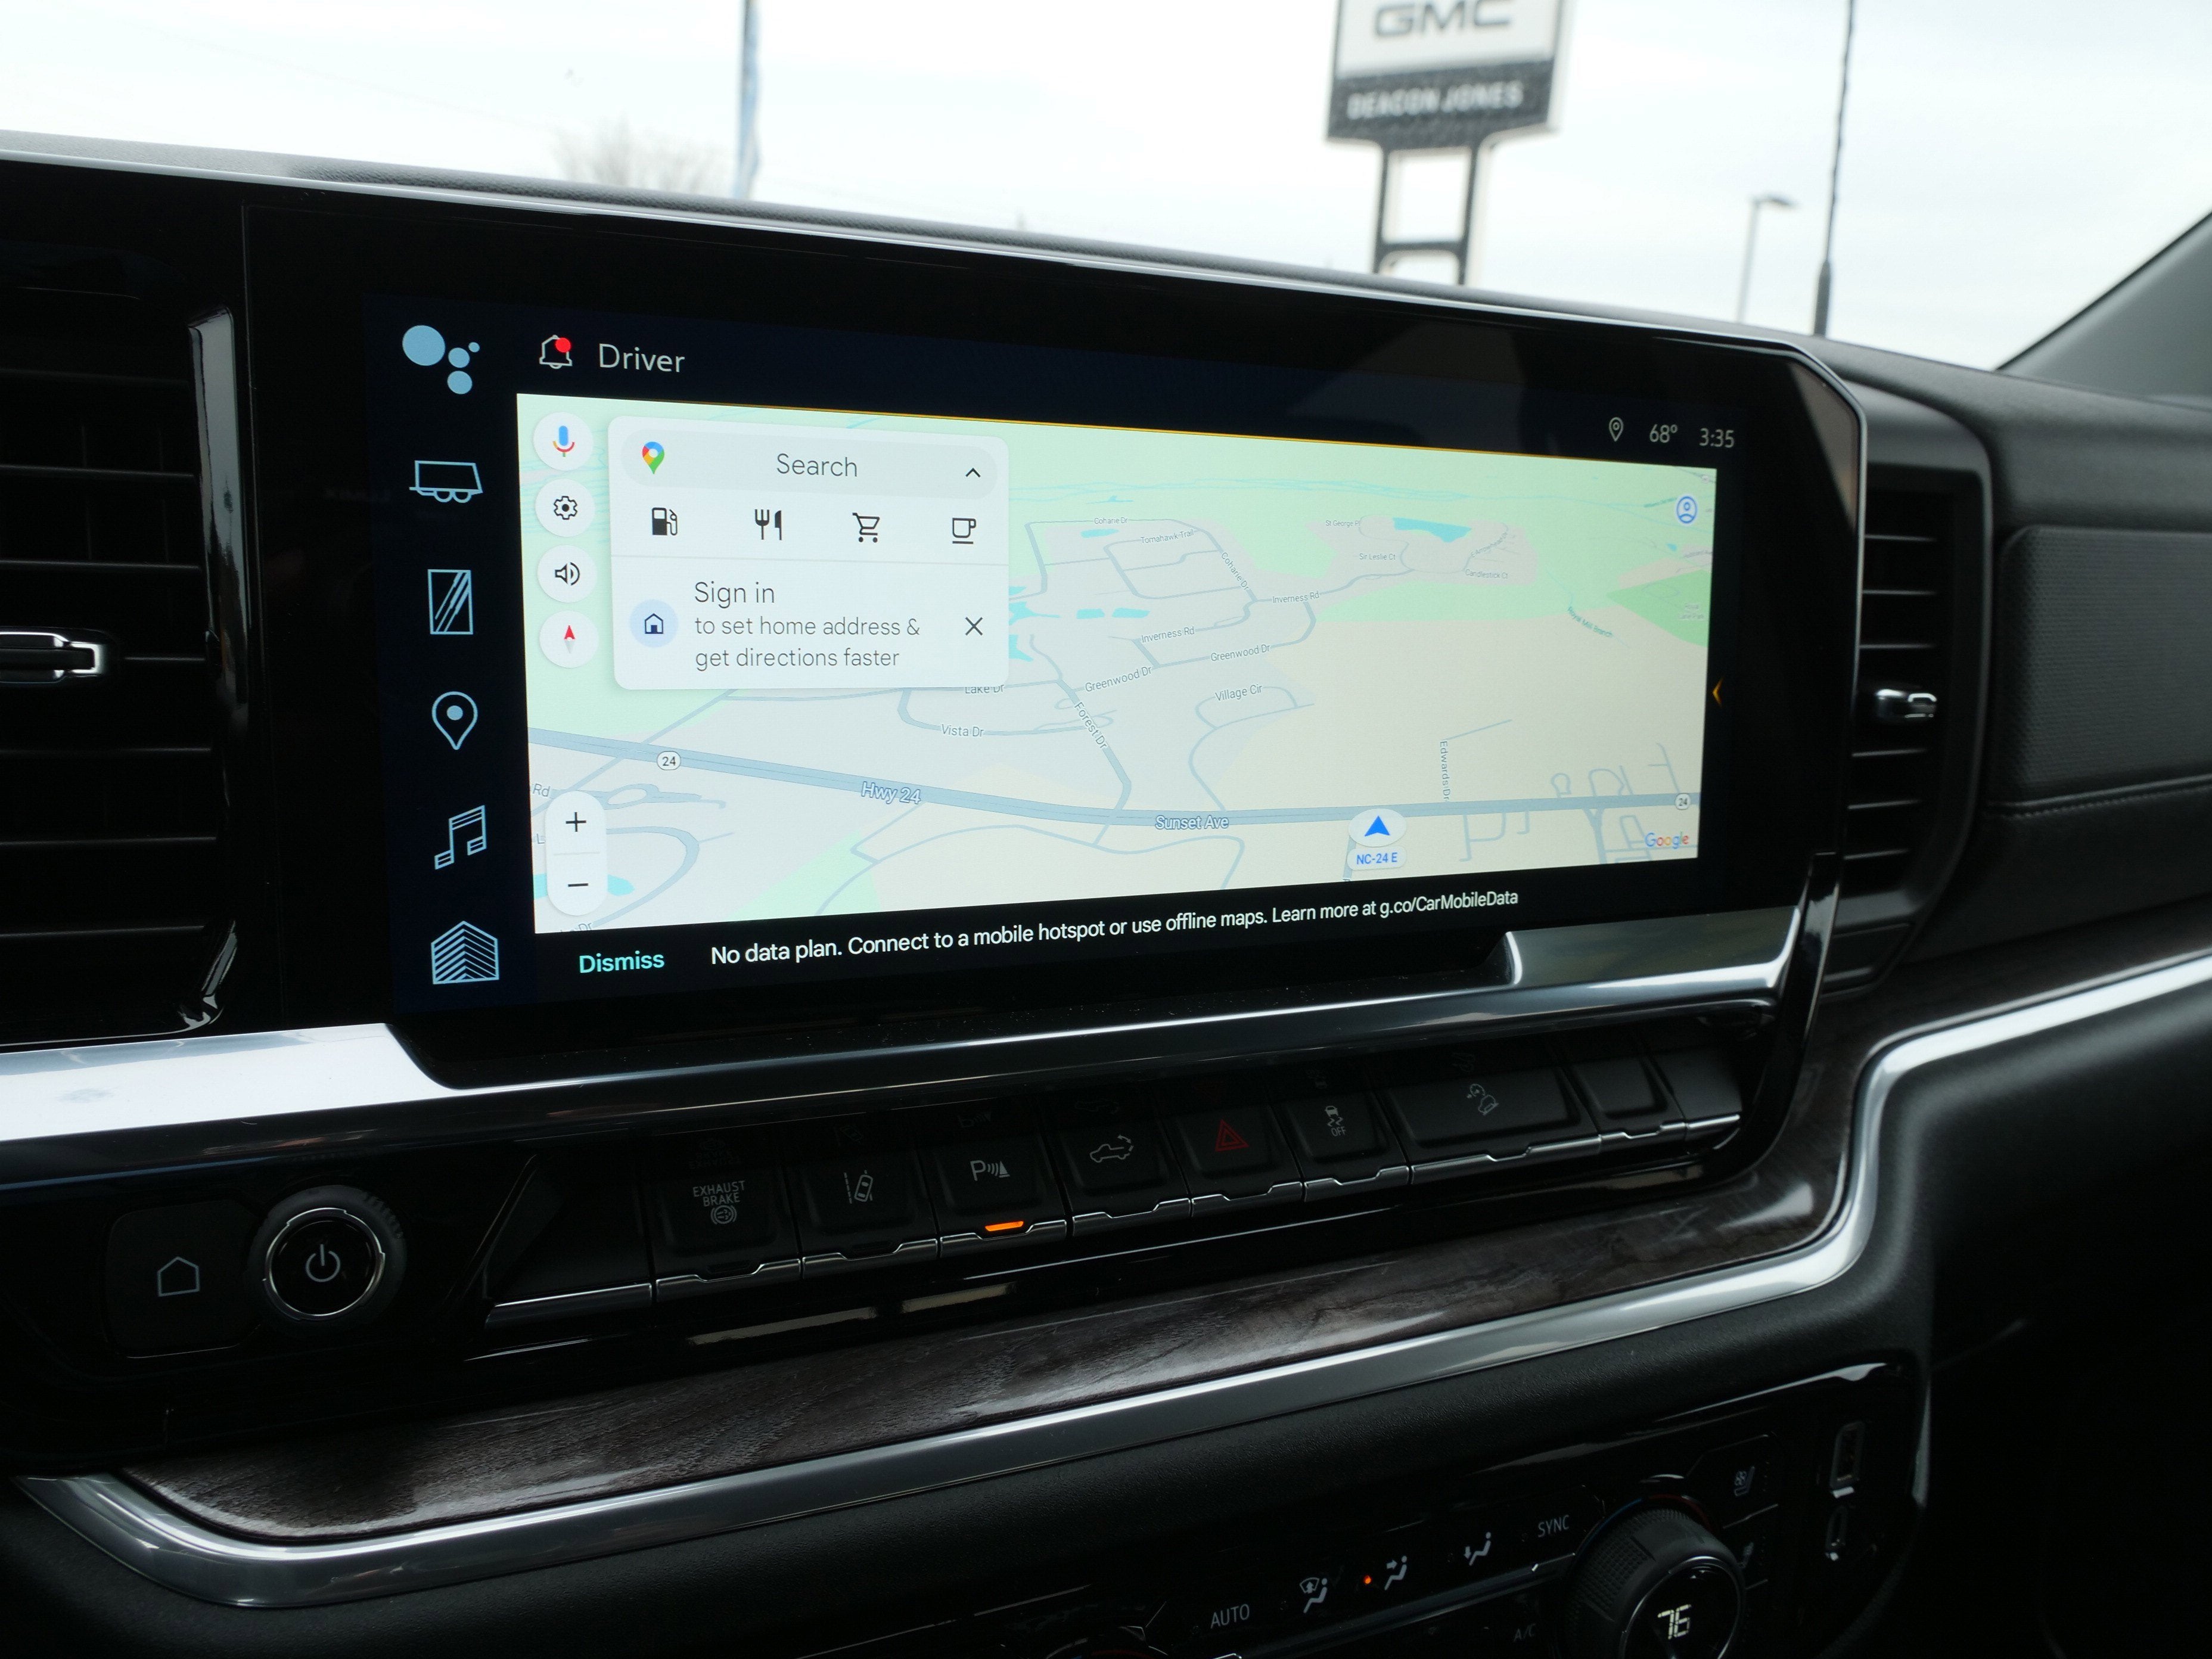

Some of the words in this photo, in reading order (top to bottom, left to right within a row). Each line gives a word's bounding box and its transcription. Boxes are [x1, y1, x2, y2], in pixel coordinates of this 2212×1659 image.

[1374, 0, 1514, 37] GMC
[1441, 81, 1524, 113] JONES
[599, 343, 685, 372] Driver
[1699, 427, 1735, 448] 3:35
[776, 453, 858, 477] Search
[1333, 520, 1353, 528] George
[1141, 533, 1179, 543] Tomahawk
[1179, 530, 1194, 538] Trail
[1221, 552, 1242, 582] Coharie
[1240, 580, 1250, 591] Dr
[1465, 568, 1500, 579] Candlestick
[695, 580, 747, 608] Sign
[756, 582, 775, 603] in
[1272, 595, 1309, 603] Inverness
[1309, 591, 1319, 599] Rd
[695, 617, 715, 634] to
[722, 617, 753, 635] set
[760, 616, 816, 635] home
[823, 617, 900, 635] address
[907, 618, 920, 635] &
[1141, 630, 1182, 643] Inverness
[1184, 626, 1195, 636] Rd
[695, 650, 729, 671] get
[737, 648, 837, 666] directions
[844, 648, 900, 666] faster
[1211, 645, 1260, 661] Greenwood
[1262, 644, 1270, 653] Dr
[1085, 669, 1140, 692] Greenwood
[1141, 666, 1152, 676] Dr
[1214, 689, 1247, 701] Village
[1250, 684, 1263, 694] Cir
[941, 724, 969, 737] Vista
[973, 726, 984, 737] Dr
[1074, 702, 1099, 737] Forest
[1095, 735, 1107, 749] Dr
[662, 756, 677, 767] 24
[1440, 741, 1450, 786] Edwards
[533, 783, 551, 797] Rd
[861, 781, 898, 804] Hwy
[899, 787, 921, 804] 24
[1443, 788, 1450, 800] Dr
[1679, 798, 1688, 806] 24
[1155, 815, 1202, 830] Sunset
[1204, 815, 1229, 829] Ave
[1645, 831, 1689, 849] Google
[1356, 853, 1388, 865] NC-24
[1391, 852, 1397, 862] E
[712, 946, 740, 964] No
[745, 943, 790, 962] data
[796, 939, 842, 963] plan.
[848, 934, 929, 954] Connect
[934, 933, 953, 948] to
[958, 934, 969, 946] a
[974, 925, 1033, 945] mobile
[1039, 921, 1105, 942] hotspot
[1110, 922, 1127, 935] or
[1132, 919, 1161, 933] use
[1166, 912, 1216, 931] offline
[1221, 912, 1267, 928] maps.
[1273, 908, 1316, 922] Learn
[1321, 905, 1358, 918] more
[1362, 901, 1376, 915] at
[1380, 891, 1518, 918] g.co/CarMobileData
[579, 950, 665, 973] Dismiss
[1330, 1126, 1346, 1137] OFF
[692, 1180, 745, 1197] EXHAUST
[703, 1192, 741, 1207] BRAKE
[1537, 1515, 1570, 1538] SYNC
[1211, 1604, 1250, 1629] AUTO
[1658, 1604, 1692, 1640] 76
[1514, 1623, 1536, 1642] A/C
